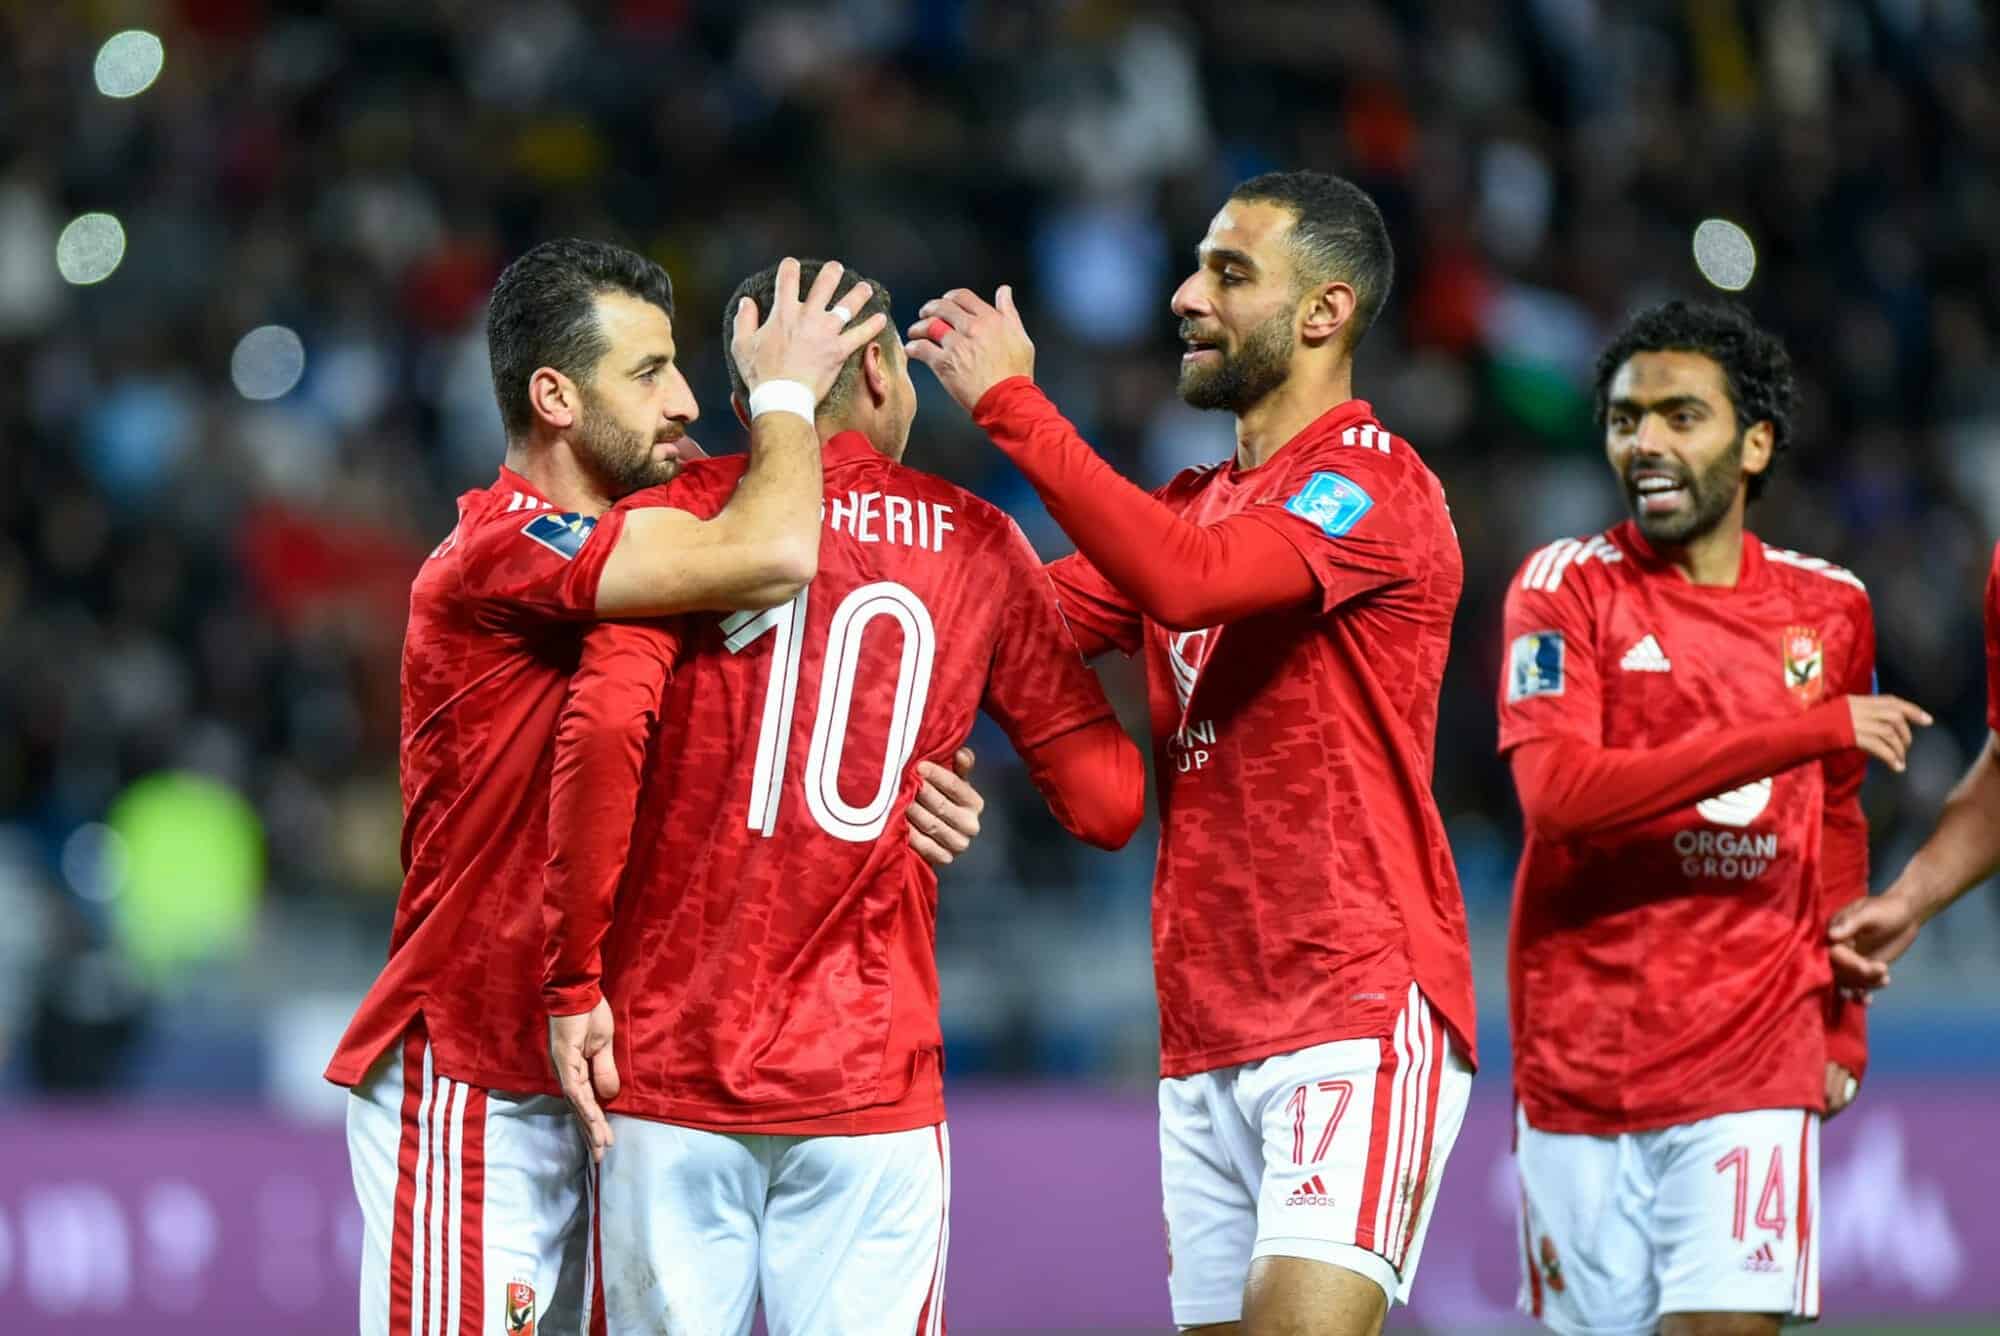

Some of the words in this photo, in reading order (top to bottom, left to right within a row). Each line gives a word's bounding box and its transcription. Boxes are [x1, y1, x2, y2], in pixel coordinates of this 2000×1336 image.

[820, 491, 954, 552] HERIF
[720, 581, 935, 842] 10
[1285, 1080, 1353, 1165] 17
[1285, 1195, 1336, 1208] adidas
[1714, 1145, 1787, 1242] 14
